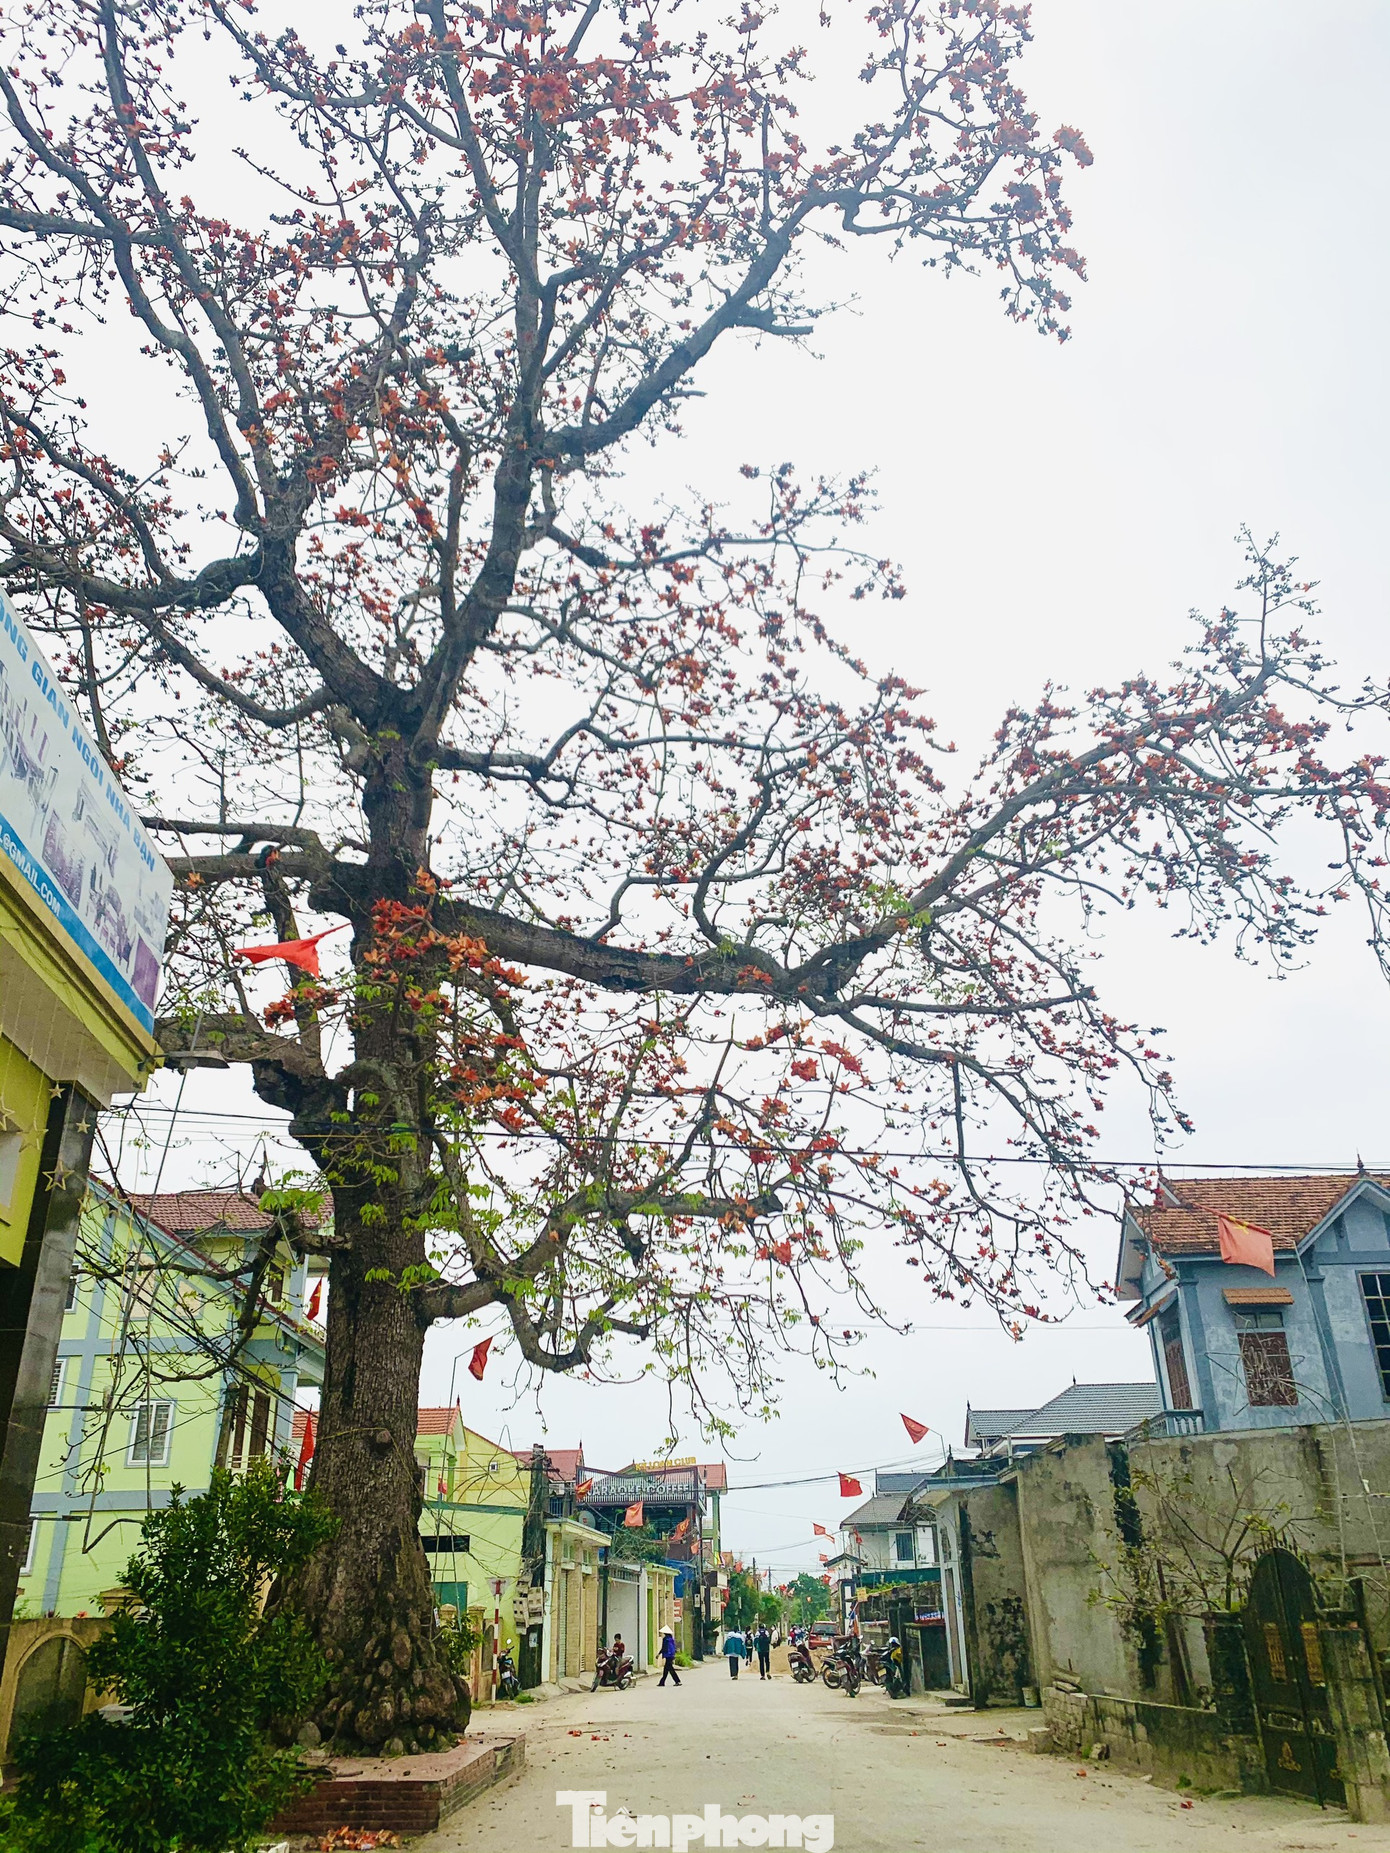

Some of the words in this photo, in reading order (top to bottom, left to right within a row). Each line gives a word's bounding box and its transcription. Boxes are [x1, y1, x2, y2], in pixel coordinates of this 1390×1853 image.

[32, 661, 69, 729] GIAN
[72, 725, 103, 786] NGÔI
[133, 826, 155, 872] BẠN
[674, 1456, 697, 1467] CLUB
